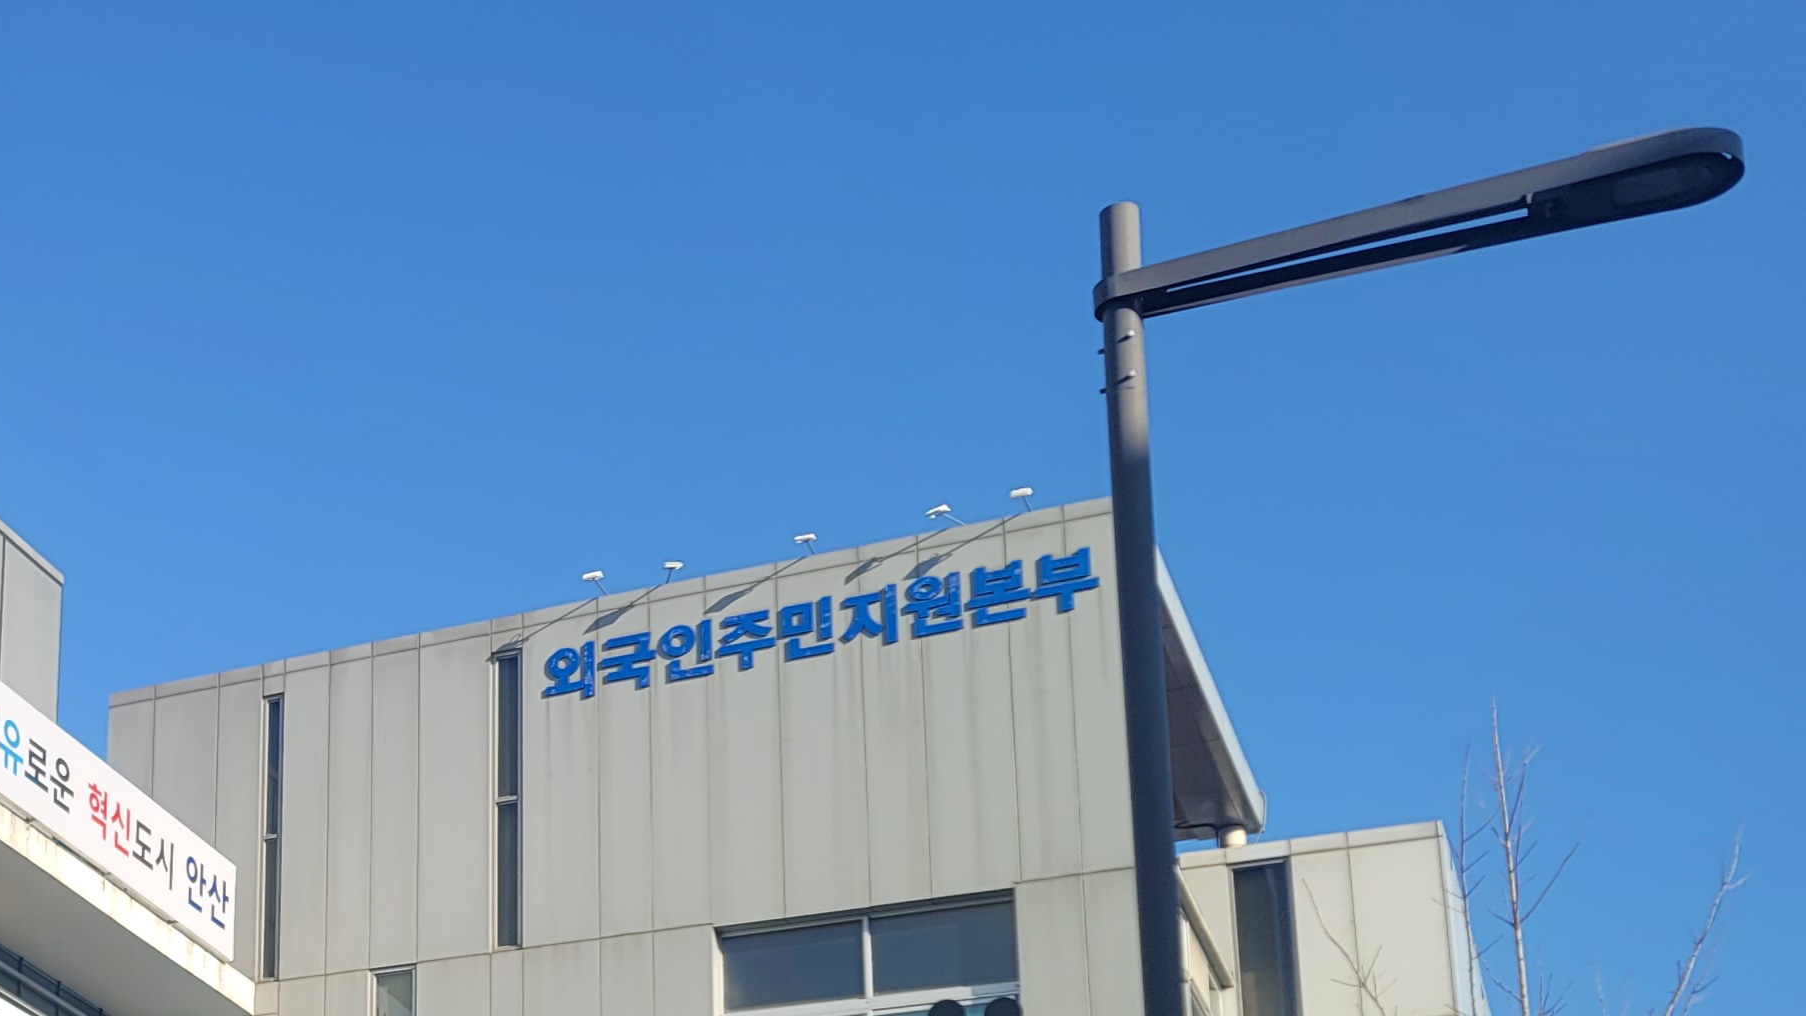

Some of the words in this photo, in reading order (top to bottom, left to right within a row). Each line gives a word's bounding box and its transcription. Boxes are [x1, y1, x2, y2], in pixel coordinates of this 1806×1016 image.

[541, 546, 1100, 700] 외국인주민지원본부
[88, 783, 174, 890] 혁신도시
[185, 856, 229, 930] 안산
